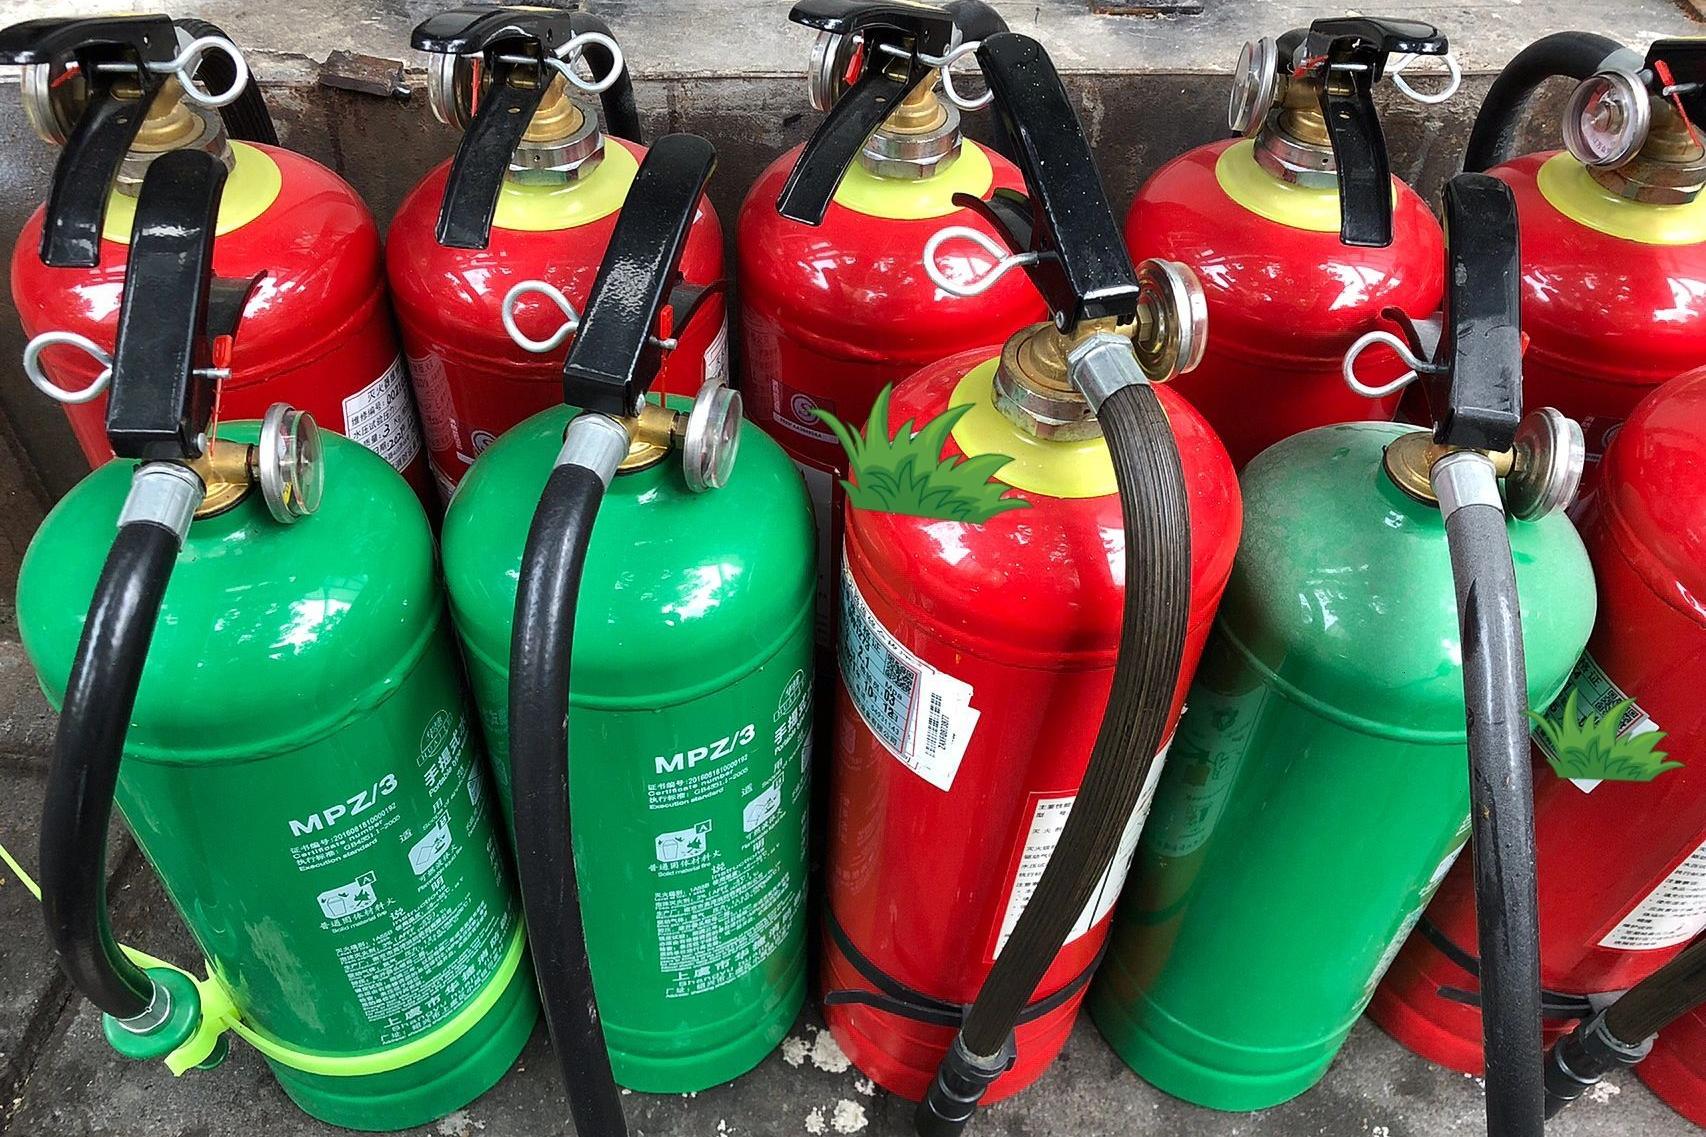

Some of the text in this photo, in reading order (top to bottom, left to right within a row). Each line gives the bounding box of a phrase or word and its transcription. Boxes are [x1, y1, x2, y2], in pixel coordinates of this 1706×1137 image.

[654, 723, 756, 774] MPZ/3
[648, 769, 734, 797] Certificate number
[691, 787, 725, 803] standard
[288, 773, 398, 837] MPZ/3
[349, 820, 383, 841] number
[699, 824, 708, 832] A
[299, 838, 378, 871] Execution standard
[363, 876, 371, 885] A
